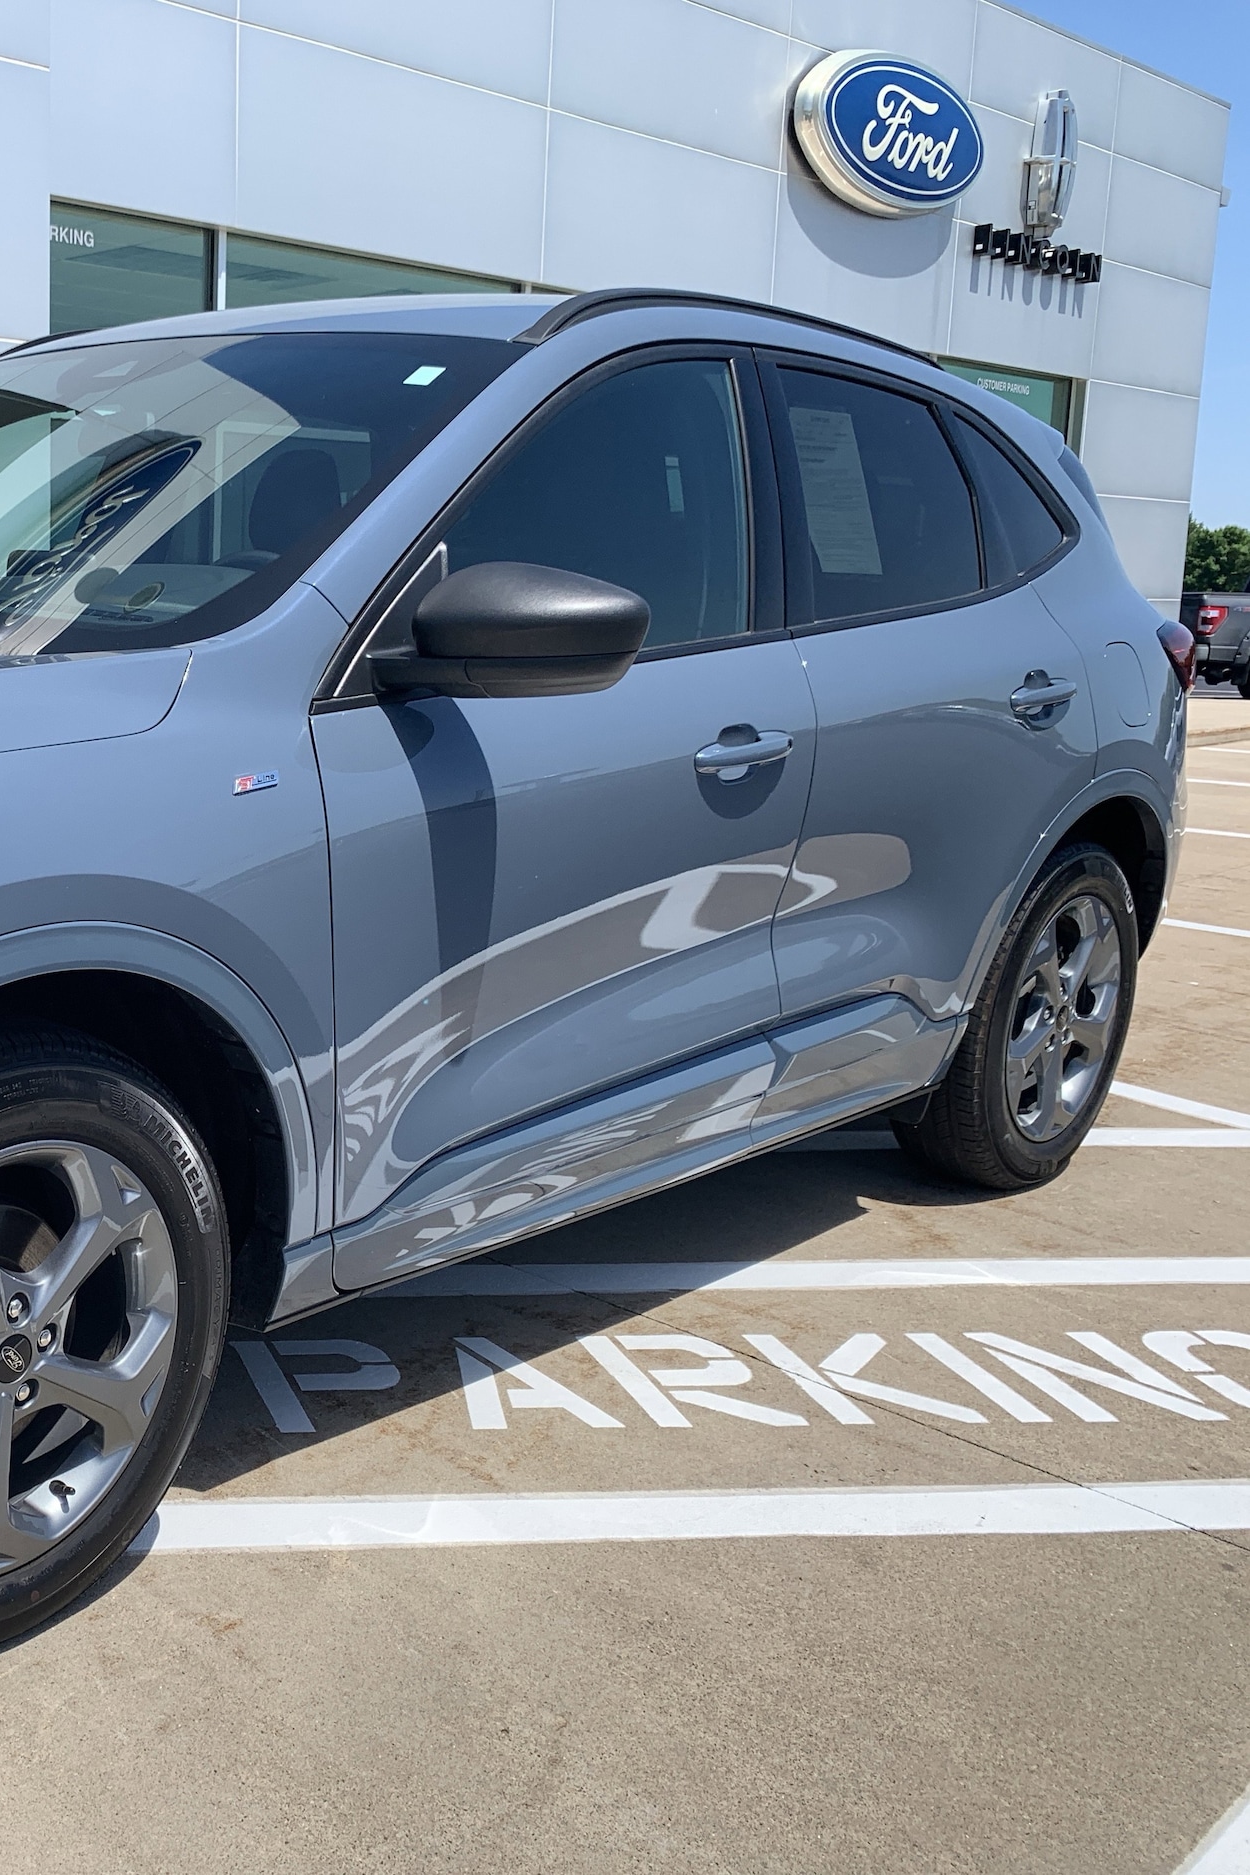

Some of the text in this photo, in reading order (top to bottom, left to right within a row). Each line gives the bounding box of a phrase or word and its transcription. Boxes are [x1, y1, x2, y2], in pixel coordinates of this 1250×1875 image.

[862, 84, 959, 181] Ford
[973, 223, 1103, 283] LINCOLN
[977, 377, 1030, 396] CUSTOMER PARKING
[144, 1113, 215, 1229] MICHELIN
